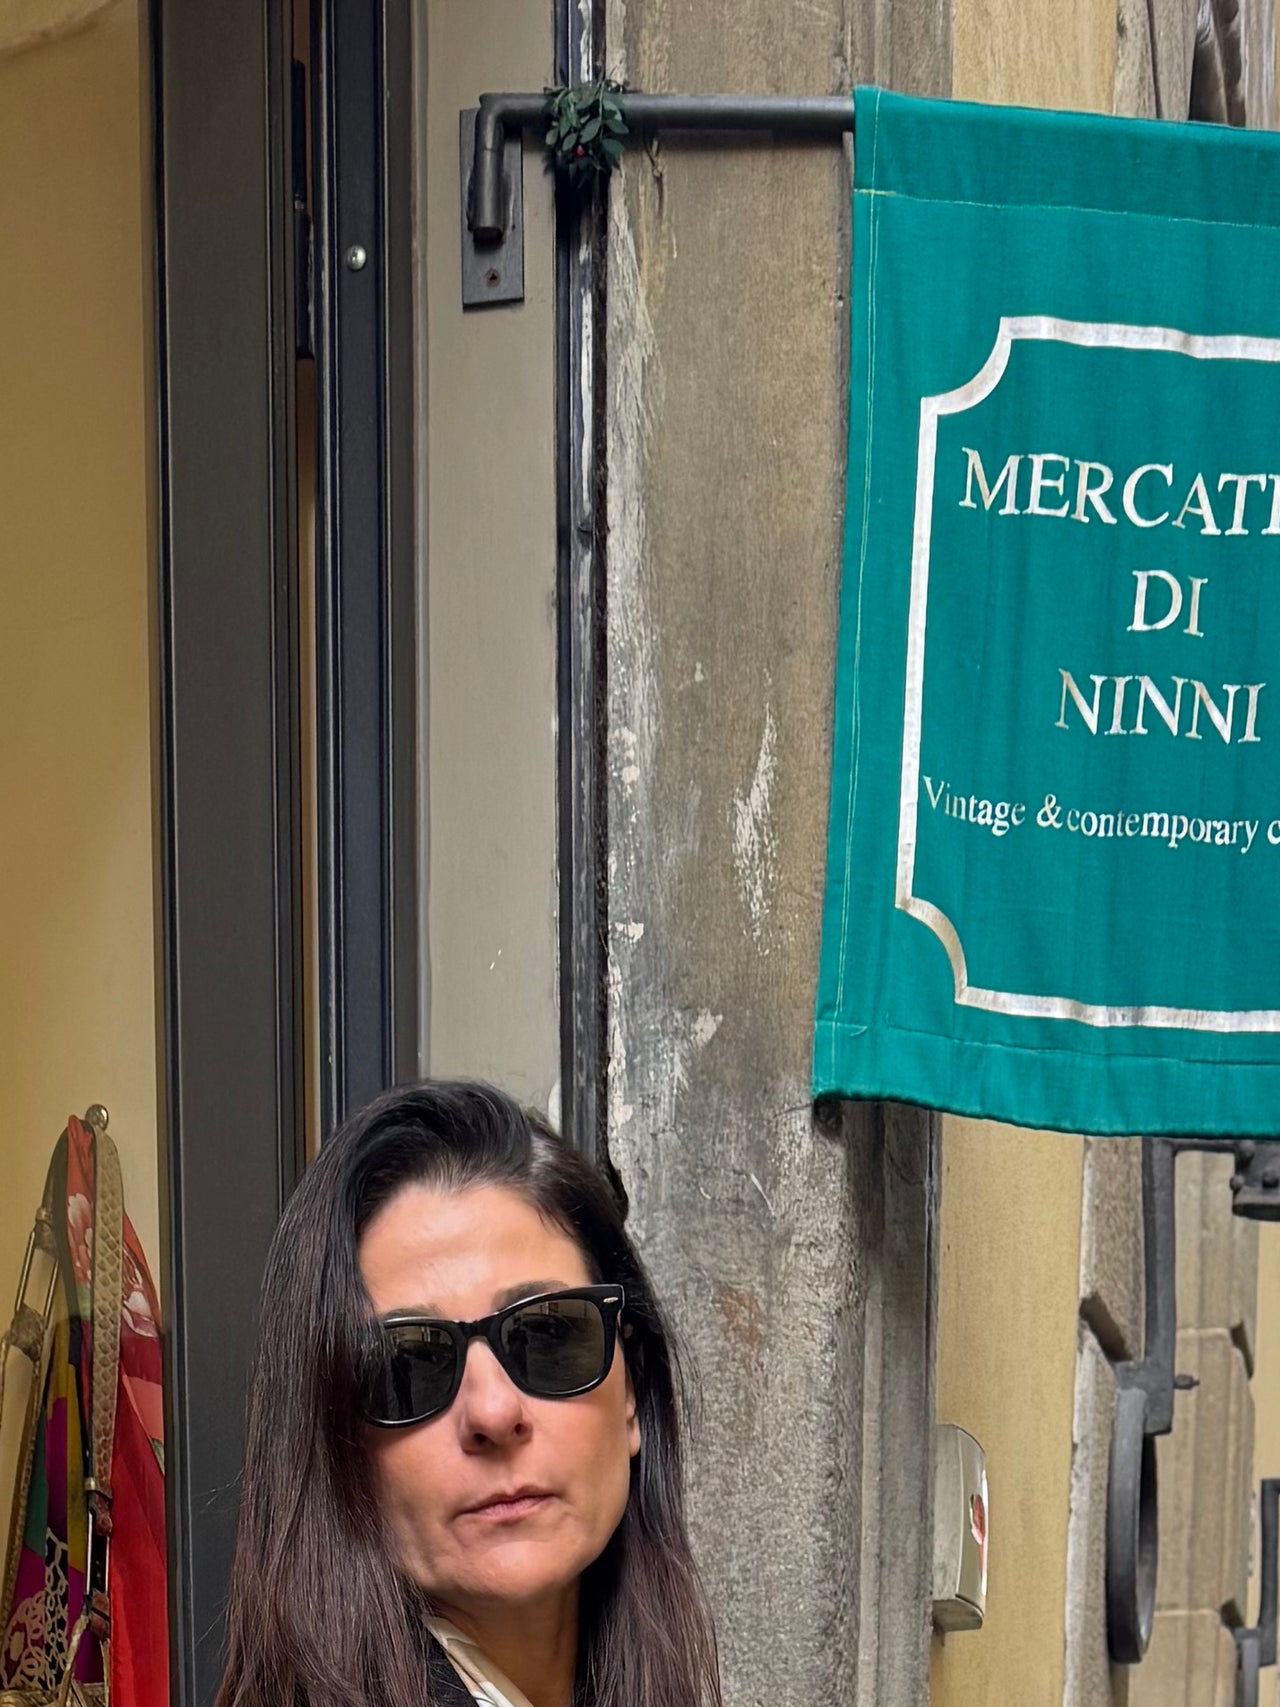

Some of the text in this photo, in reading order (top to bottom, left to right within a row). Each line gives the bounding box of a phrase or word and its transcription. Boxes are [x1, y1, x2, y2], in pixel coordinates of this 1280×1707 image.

[1127, 569, 1208, 639] DI
[1055, 670, 1266, 745] NINNI
[923, 775, 1026, 836] Vintage
